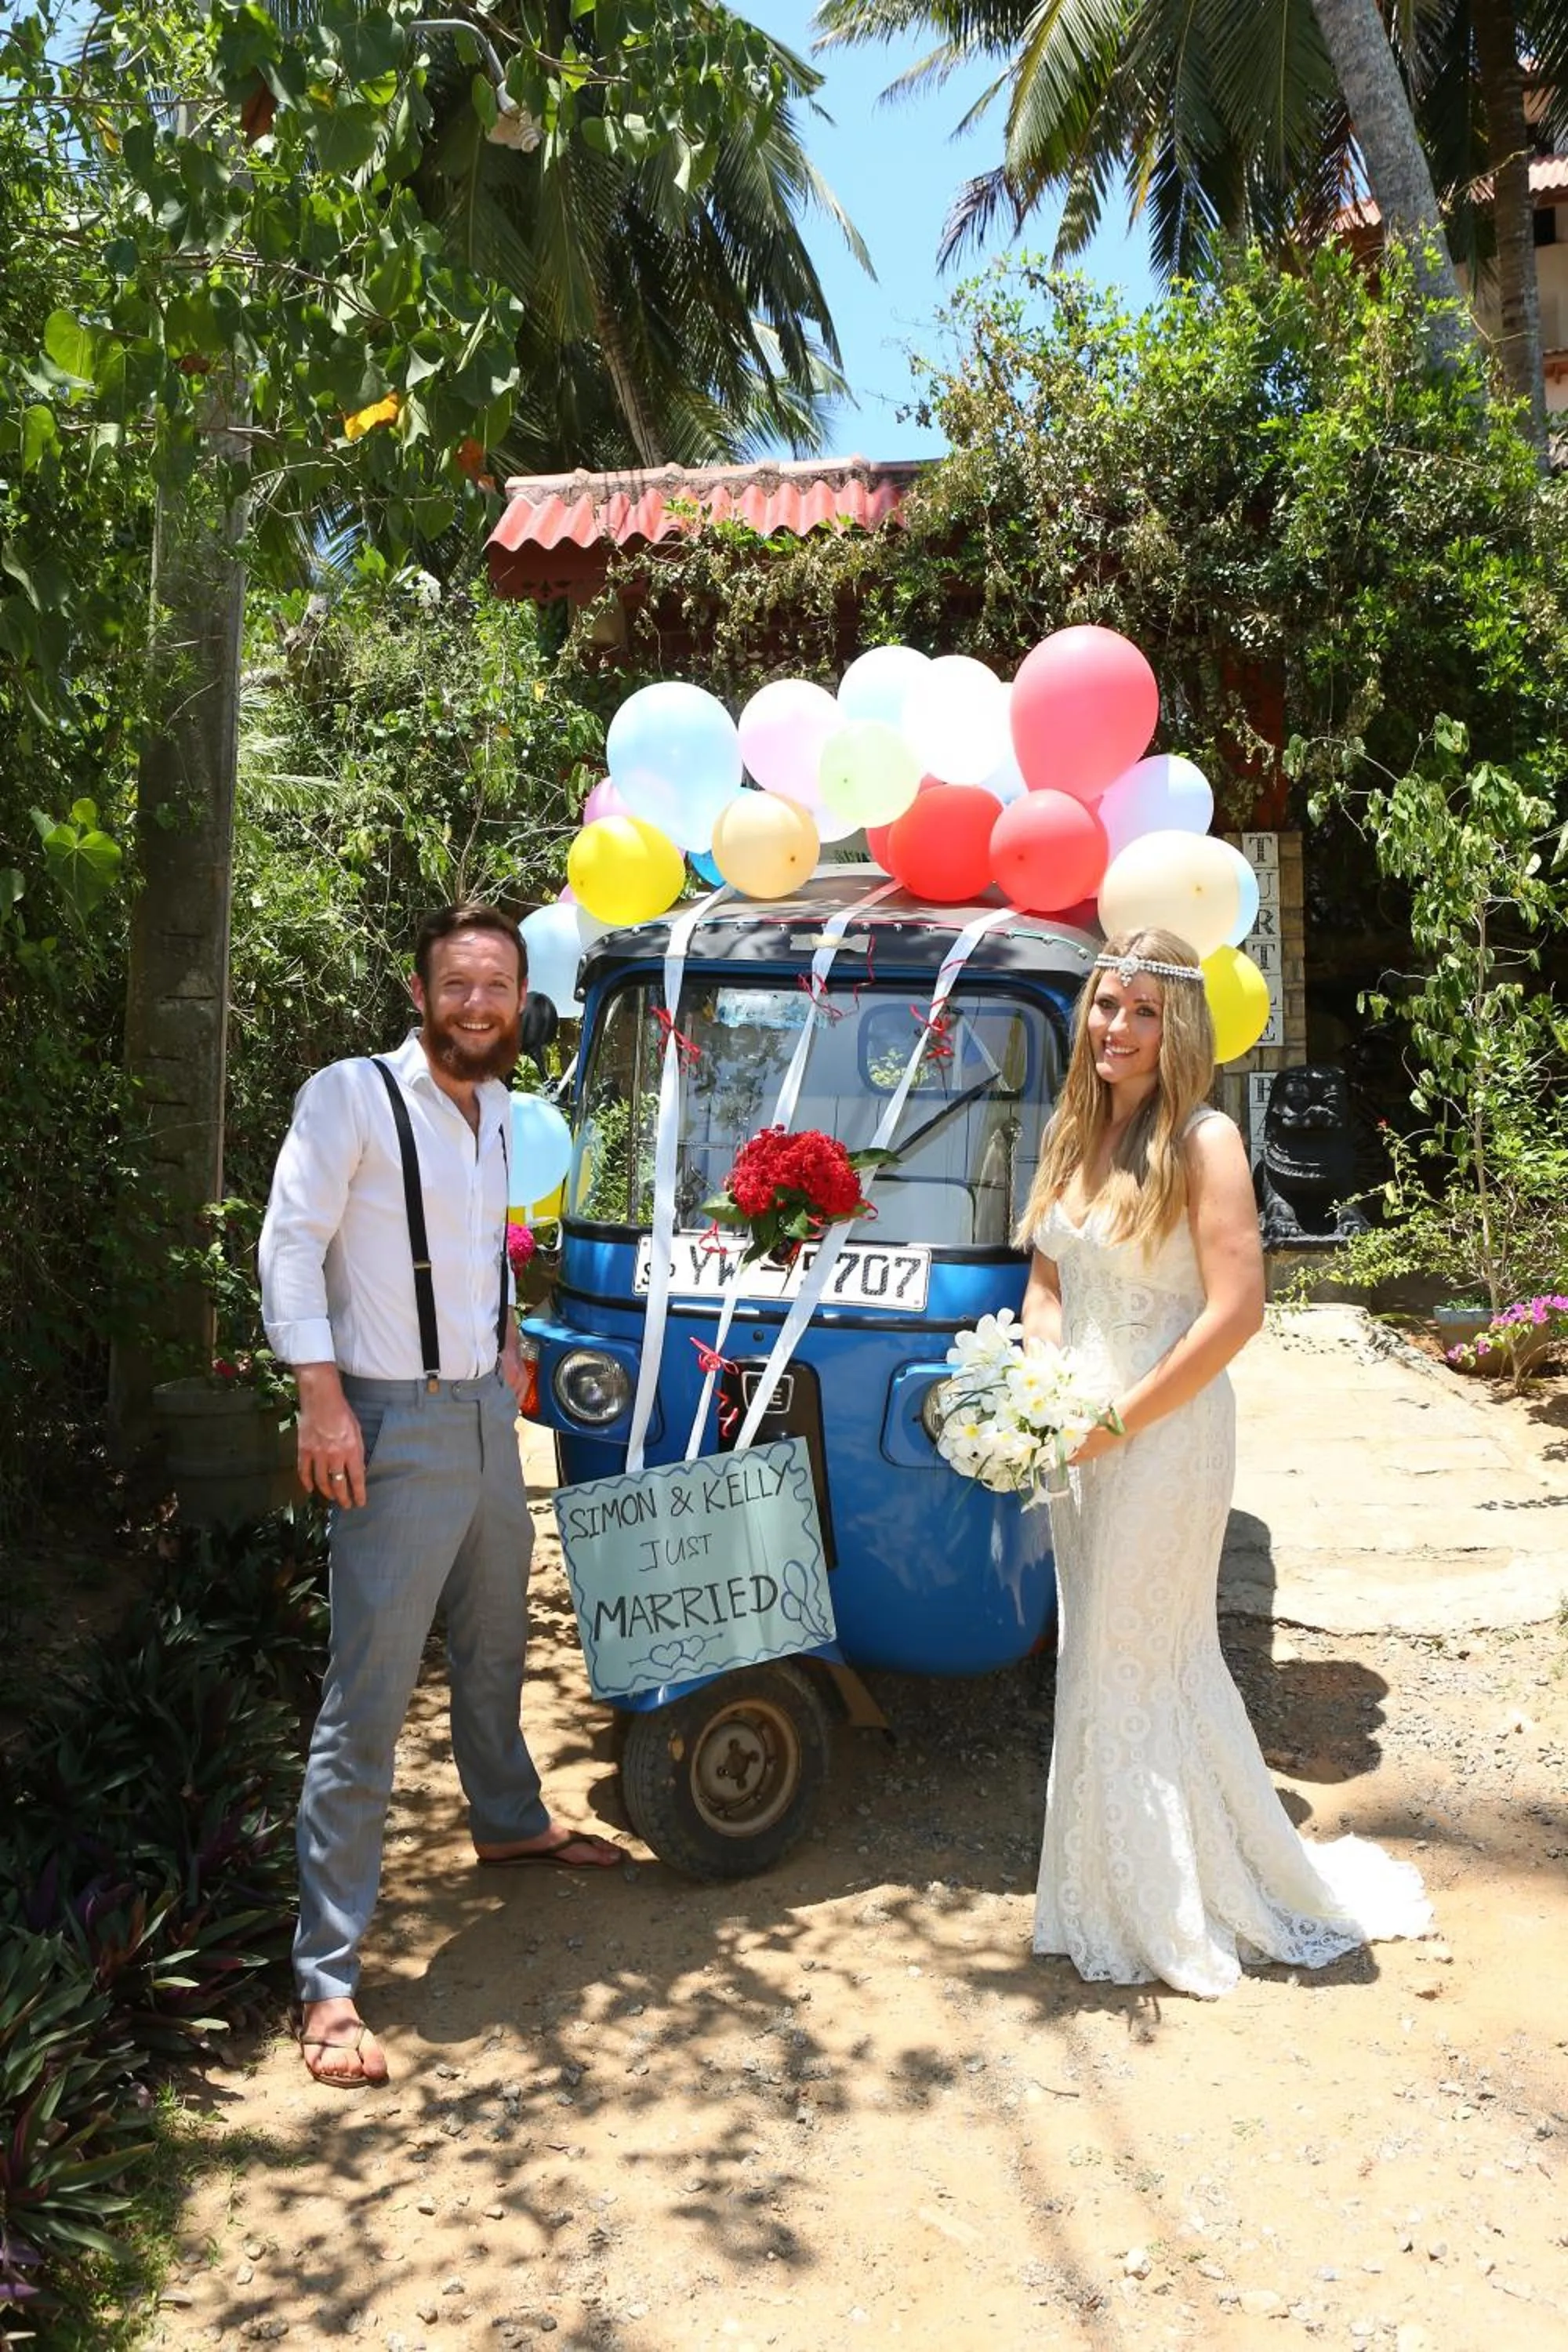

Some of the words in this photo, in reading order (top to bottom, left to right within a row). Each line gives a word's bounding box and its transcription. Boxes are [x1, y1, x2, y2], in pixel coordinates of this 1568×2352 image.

[1249, 837, 1277, 1042] TURTE
[570, 1488, 657, 1541] SIMON
[670, 1486, 694, 1517] &
[702, 1460, 790, 1513] KELLY
[639, 1534, 712, 1571] JUST
[593, 1575, 779, 1642] MARRIED
